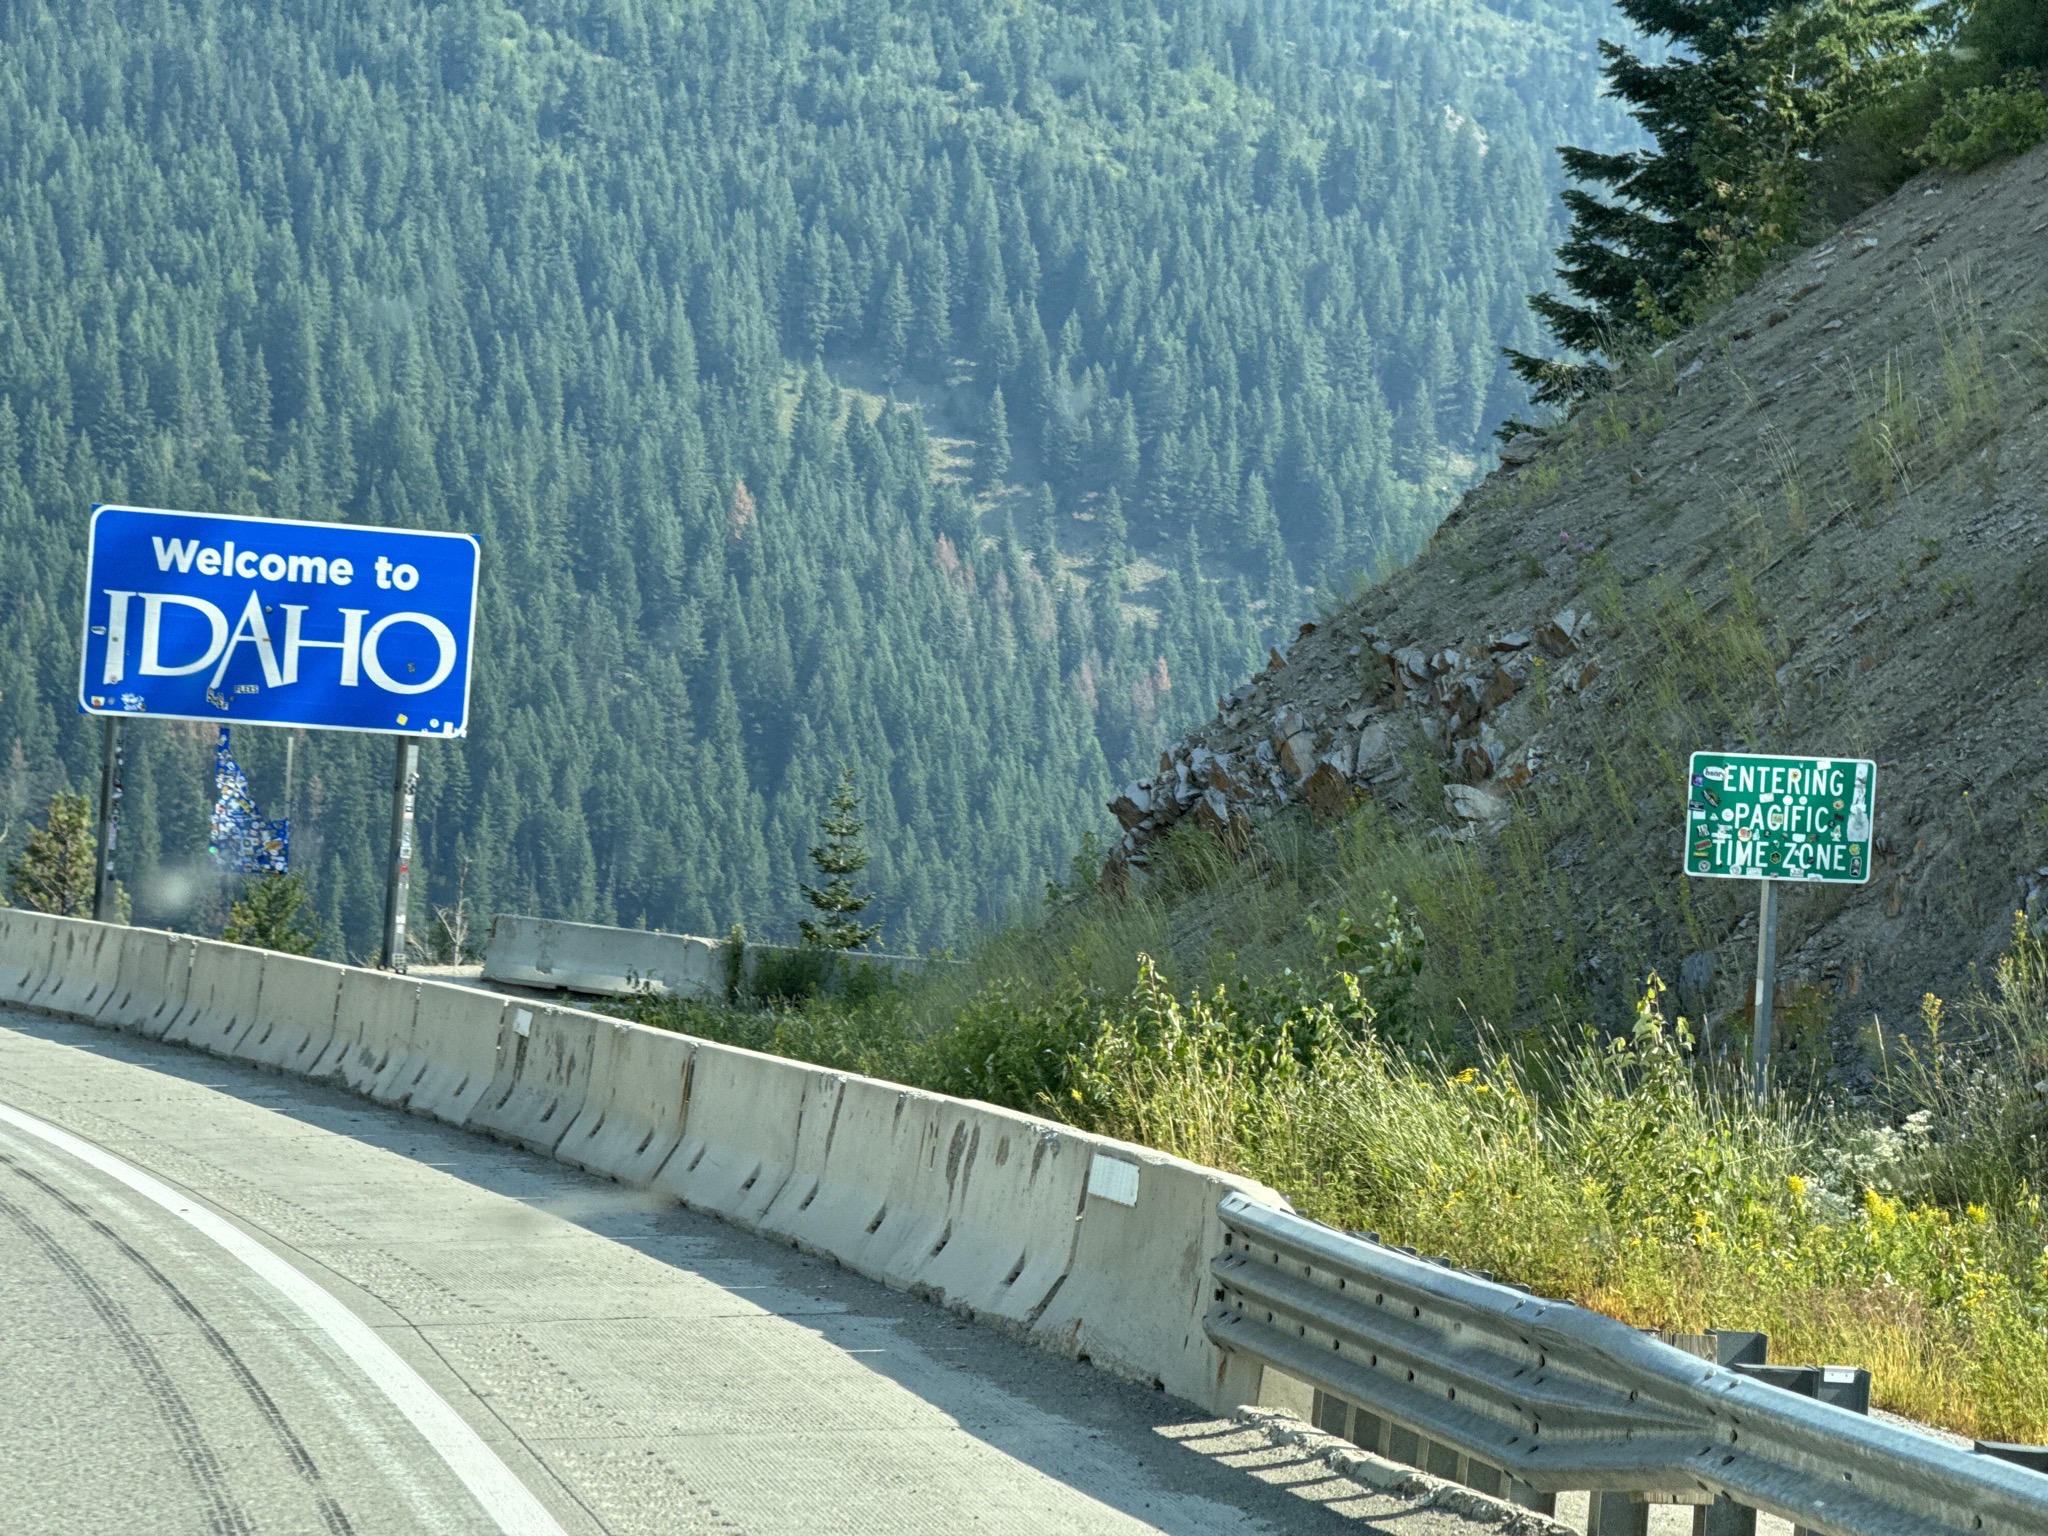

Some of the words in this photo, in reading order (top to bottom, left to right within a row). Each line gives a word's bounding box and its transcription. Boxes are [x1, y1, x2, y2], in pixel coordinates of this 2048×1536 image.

[152, 536, 354, 586] Welcome
[375, 556, 419, 591] to
[103, 589, 457, 695] IDAHO
[1723, 765, 1844, 797] ENTERING
[1734, 803, 1829, 833] PACIFIC
[1712, 839, 1770, 868] TIME
[1782, 842, 1847, 871] ZONE
